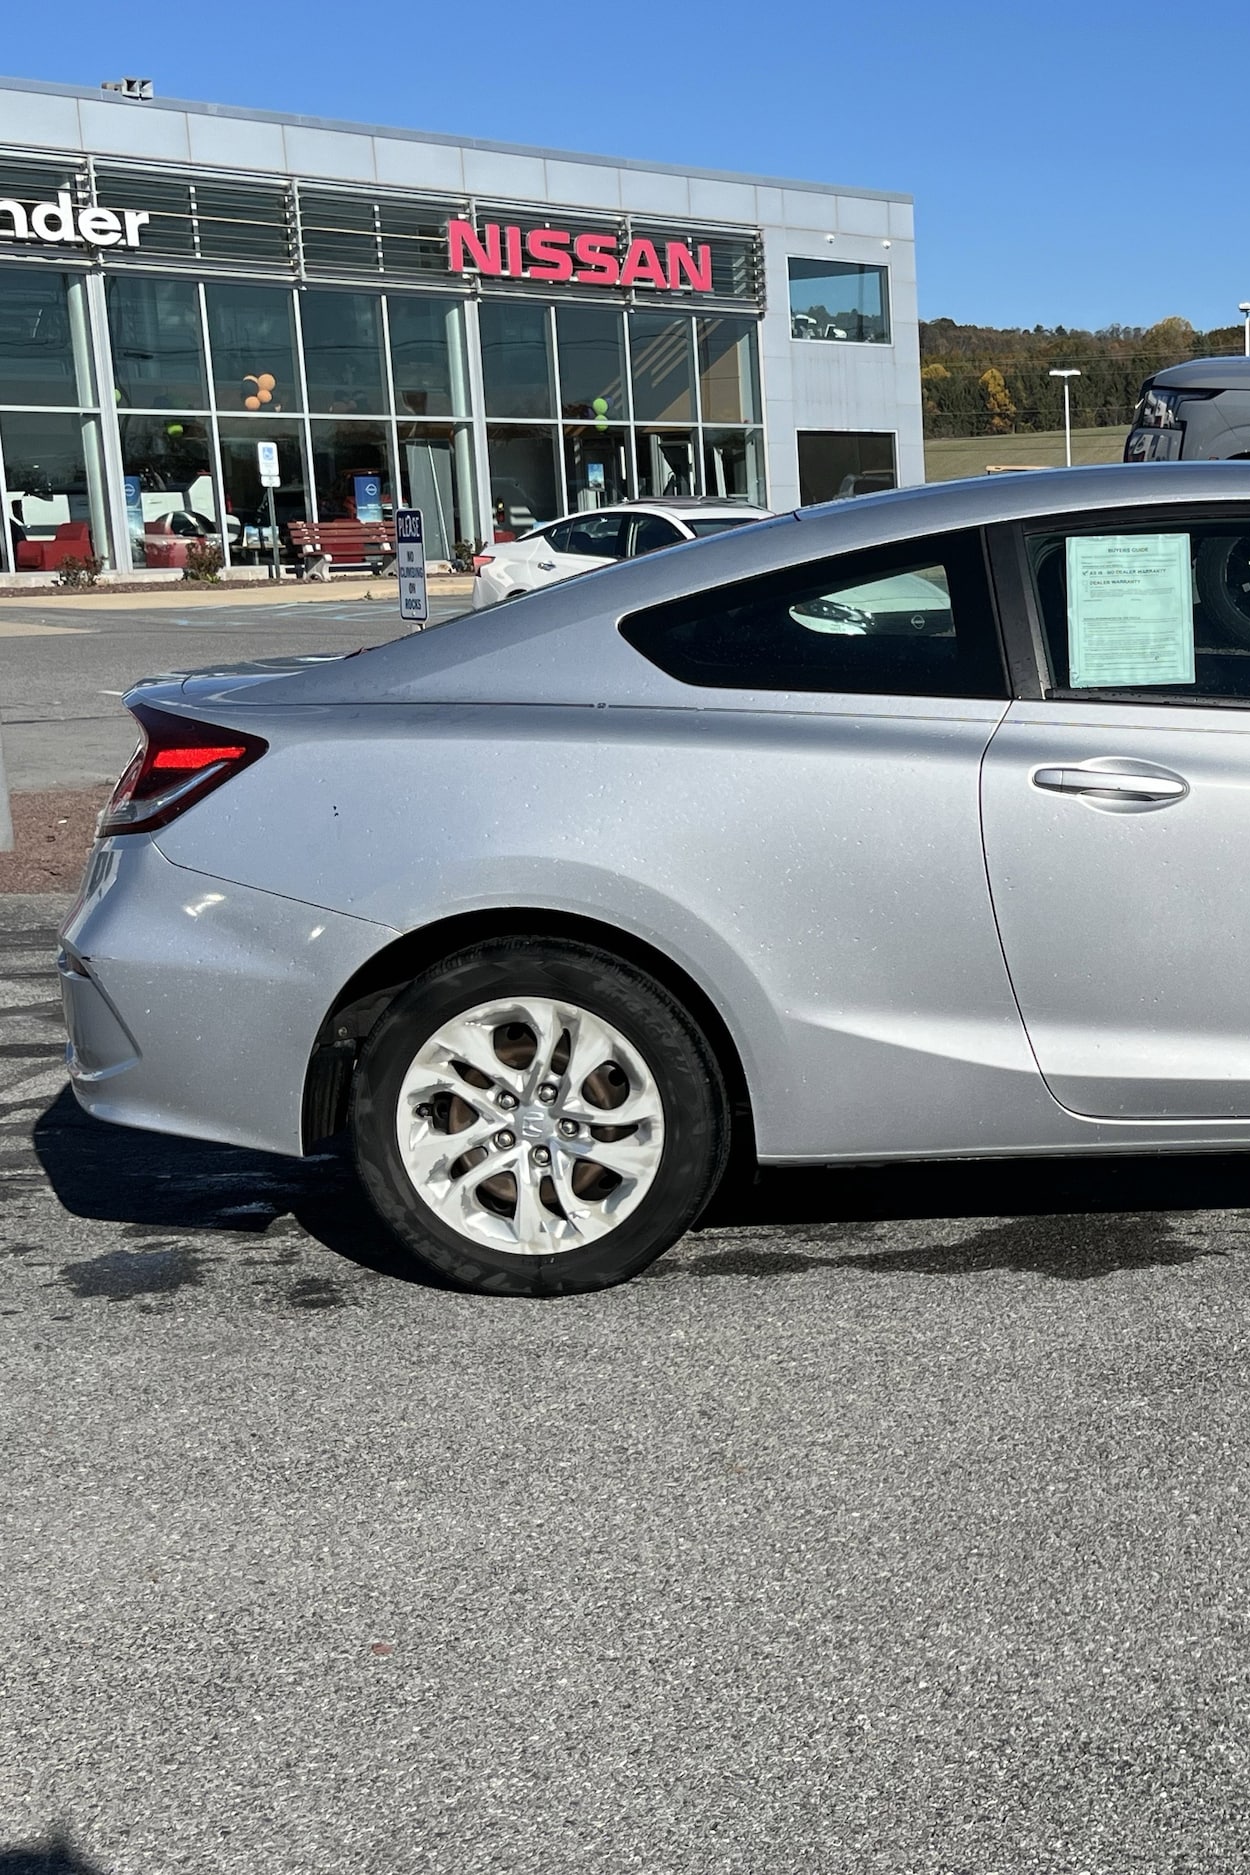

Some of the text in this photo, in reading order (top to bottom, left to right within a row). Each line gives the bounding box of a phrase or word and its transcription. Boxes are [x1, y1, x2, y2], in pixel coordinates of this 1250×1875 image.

[0, 182, 150, 247] nder
[448, 218, 714, 292] NISSAN
[398, 515, 420, 537] PLEASE
[407, 551, 414, 562] NO
[400, 567, 423, 578] CLIMBING
[408, 583, 416, 593] ON
[405, 598, 421, 610] ROCKS
